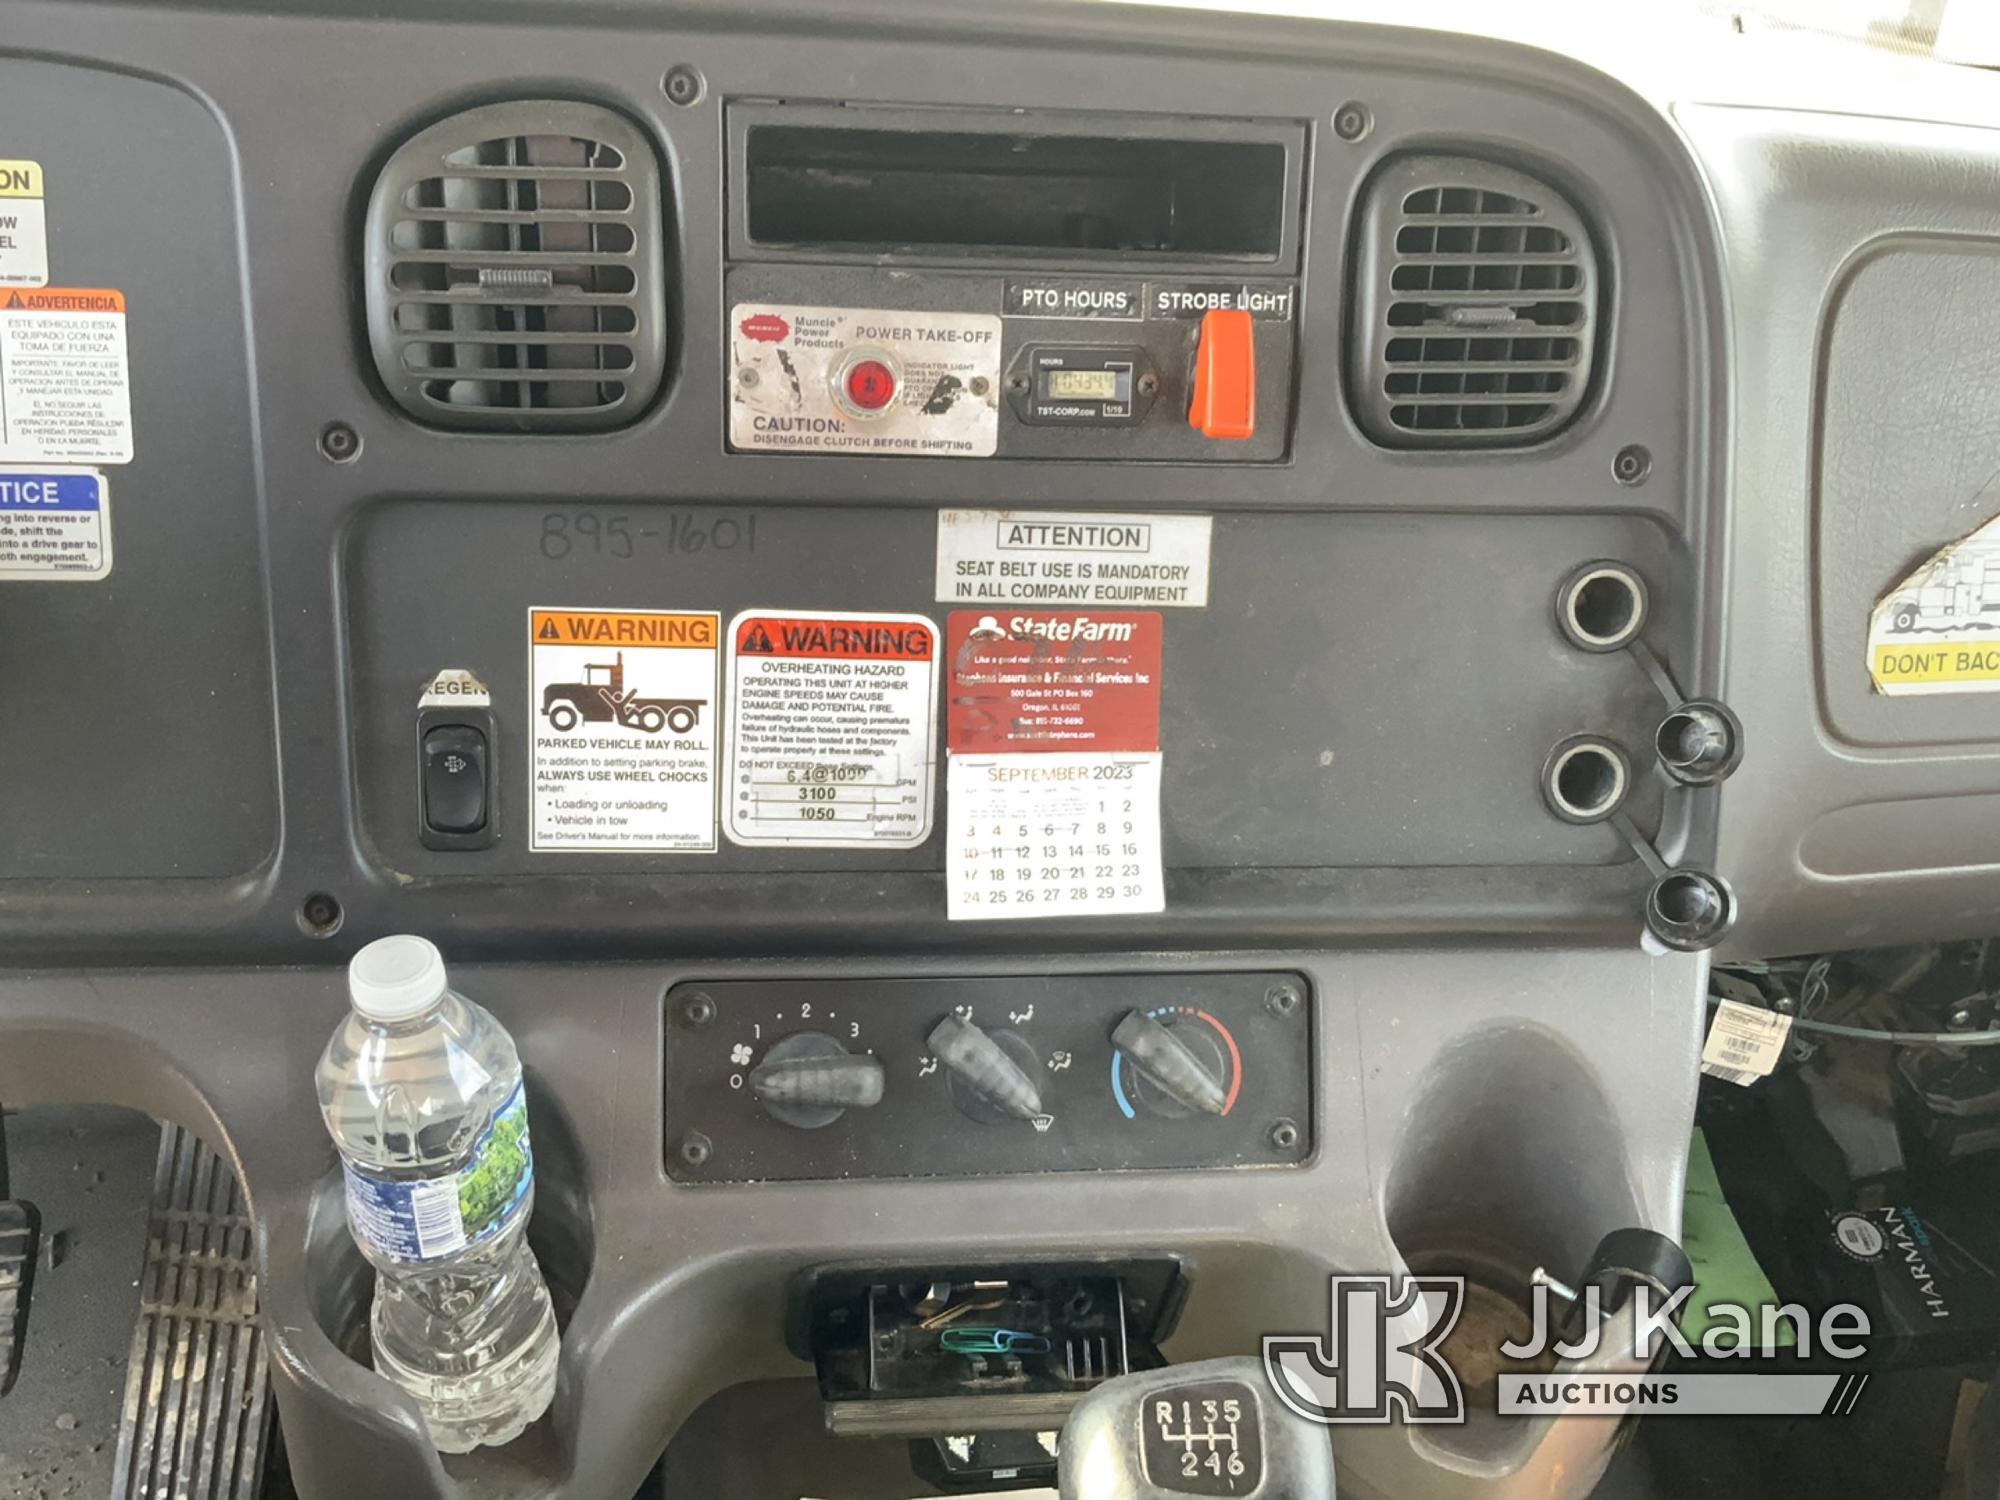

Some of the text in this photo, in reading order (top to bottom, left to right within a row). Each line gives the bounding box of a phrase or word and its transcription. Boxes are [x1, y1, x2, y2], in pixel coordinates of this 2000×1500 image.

[27, 295, 118, 310] ADVERTENCIA
[1022, 289, 1128, 309] PTO HOURS
[1157, 292, 1288, 311] STROBE LIGHT
[8, 319, 33, 328] ESTE
[91, 320, 116, 330] ESTA
[795, 316, 836, 327] Muncie
[11, 330, 115, 341] EQUIPADO CON UNA
[794, 326, 830, 338] Power
[856, 326, 993, 344] POWER TAKE-OFF
[20, 342, 110, 352] TOMA DE FUERZA
[794, 338, 845, 349] Products
[1040, 358, 1064, 366] HOURS
[753, 415, 846, 433] CAUTION:
[753, 434, 973, 450] DISENGAGE CLUTCH BEFORE SHIFTING
[14, 514, 35, 522] into
[20, 526, 64, 536] shift the
[539, 513, 756, 560] 895-1601
[1008, 524, 1142, 547] ATTENTION
[32, 539, 98, 550] drive gear to
[20, 554, 88, 562] engagement.
[956, 560, 1190, 580] SEAT BELT USE IS MANDATORY
[956, 582, 1188, 602] IN ALL COMPANY EQUIPMENT
[568, 617, 710, 643] WARNING
[781, 626, 928, 656] WARNING
[762, 662, 905, 676] OVERHEATING HAZARD
[1882, 651, 2000, 674] DON'T BAC
[744, 676, 909, 690] OPERATING THIS UNIT AT HIGHER
[742, 688, 884, 702] ENGINE SPEEDS MAY CAUSE
[1052, 689, 1064, 698] PO
[742, 700, 894, 714] DAMAGE AND POTENTIAL FIRE.
[536, 738, 710, 750] PARKED VEHICLE MAY ROLL.
[537, 756, 708, 770] In addition to setting parking brake,
[739, 759, 753, 768] DO
[754, 760, 774, 770] NOT
[776, 761, 814, 770] EXCEED
[537, 770, 708, 783] ALWAYS USE WHEEL CHOCKS
[988, 766, 1133, 782] SEPTEMBER 2023
[537, 784, 566, 792] when:
[798, 787, 836, 800] 3100
[555, 800, 668, 812] Loading or unloading
[1098, 801, 1104, 812] 1
[1123, 800, 1132, 812] 2
[555, 815, 628, 826] Vehicle in tow
[799, 807, 836, 820] 1050
[866, 813, 916, 823] Engine RPM
[537, 832, 553, 840] See
[555, 832, 586, 841] Driver's
[588, 832, 619, 841] Manual
[620, 832, 632, 840] for
[655, 832, 701, 841] information.
[966, 822, 1132, 837] 3 4 5 6 7 8 9
[964, 843, 1138, 860] 10 11 12 13 14 15 16
[990, 864, 1140, 881] 18 19 20 21 22 23
[989, 891, 1007, 904] 25
[1016, 890, 1034, 902] 26
[1043, 889, 1060, 901] 27
[1070, 888, 1088, 900] 28
[1096, 887, 1115, 899] 29
[1123, 884, 1142, 897] 30
[802, 1003, 811, 1018] 2
[754, 1024, 760, 1039] 1
[850, 1022, 860, 1038] 3
[1879, 1206, 1950, 1318] HARMAN
[1156, 1398, 1242, 1425] R 1 3 5
[1180, 1450, 1246, 1477] 2 4 6
